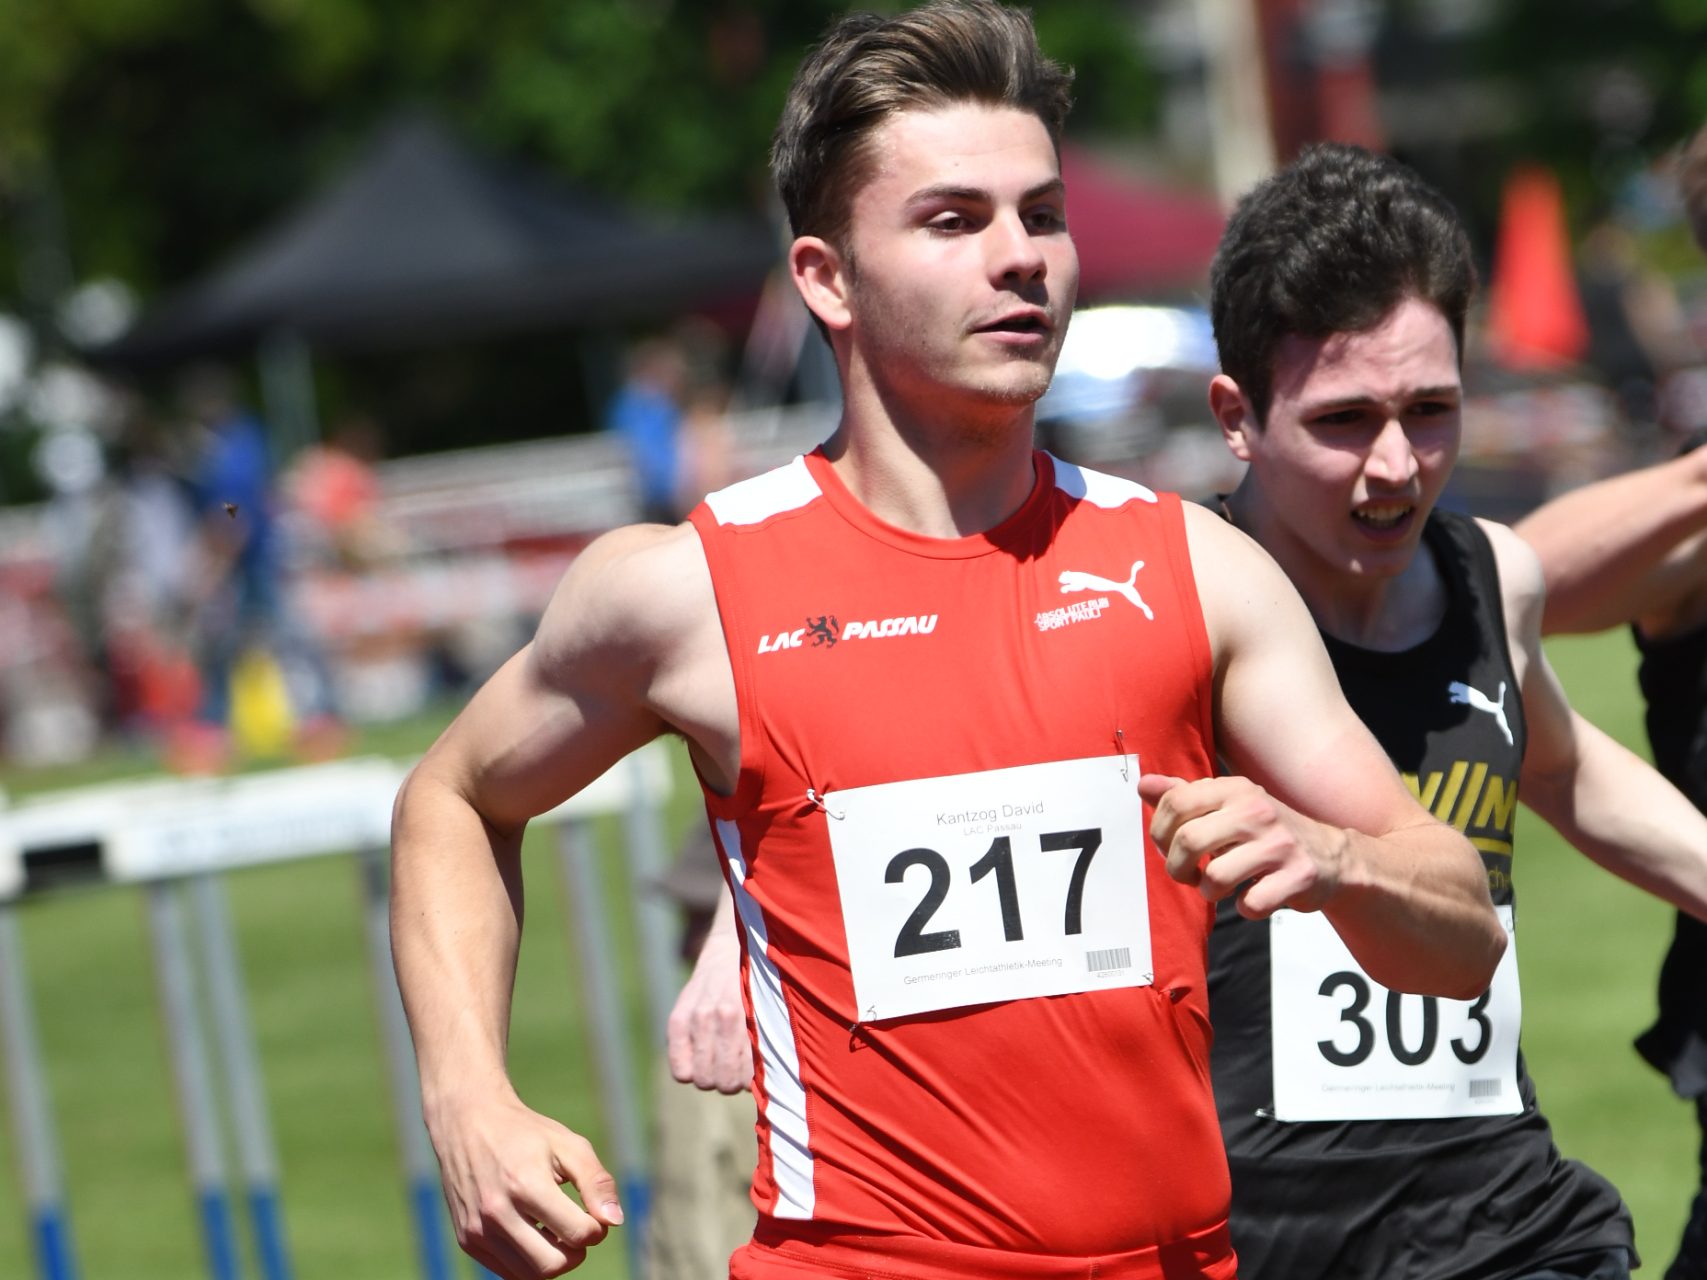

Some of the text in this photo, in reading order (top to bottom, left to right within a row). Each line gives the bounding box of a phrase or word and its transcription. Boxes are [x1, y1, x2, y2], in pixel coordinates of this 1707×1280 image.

[757, 614, 939, 654] LAC PASSAU
[936, 800, 1045, 826] Kantzog David
[963, 822, 1022, 837] LAC Passau
[884, 827, 1103, 959] 217
[903, 956, 1064, 985] Germeringer Leichtathletik-Meeting
[1316, 970, 1493, 1067] 303
